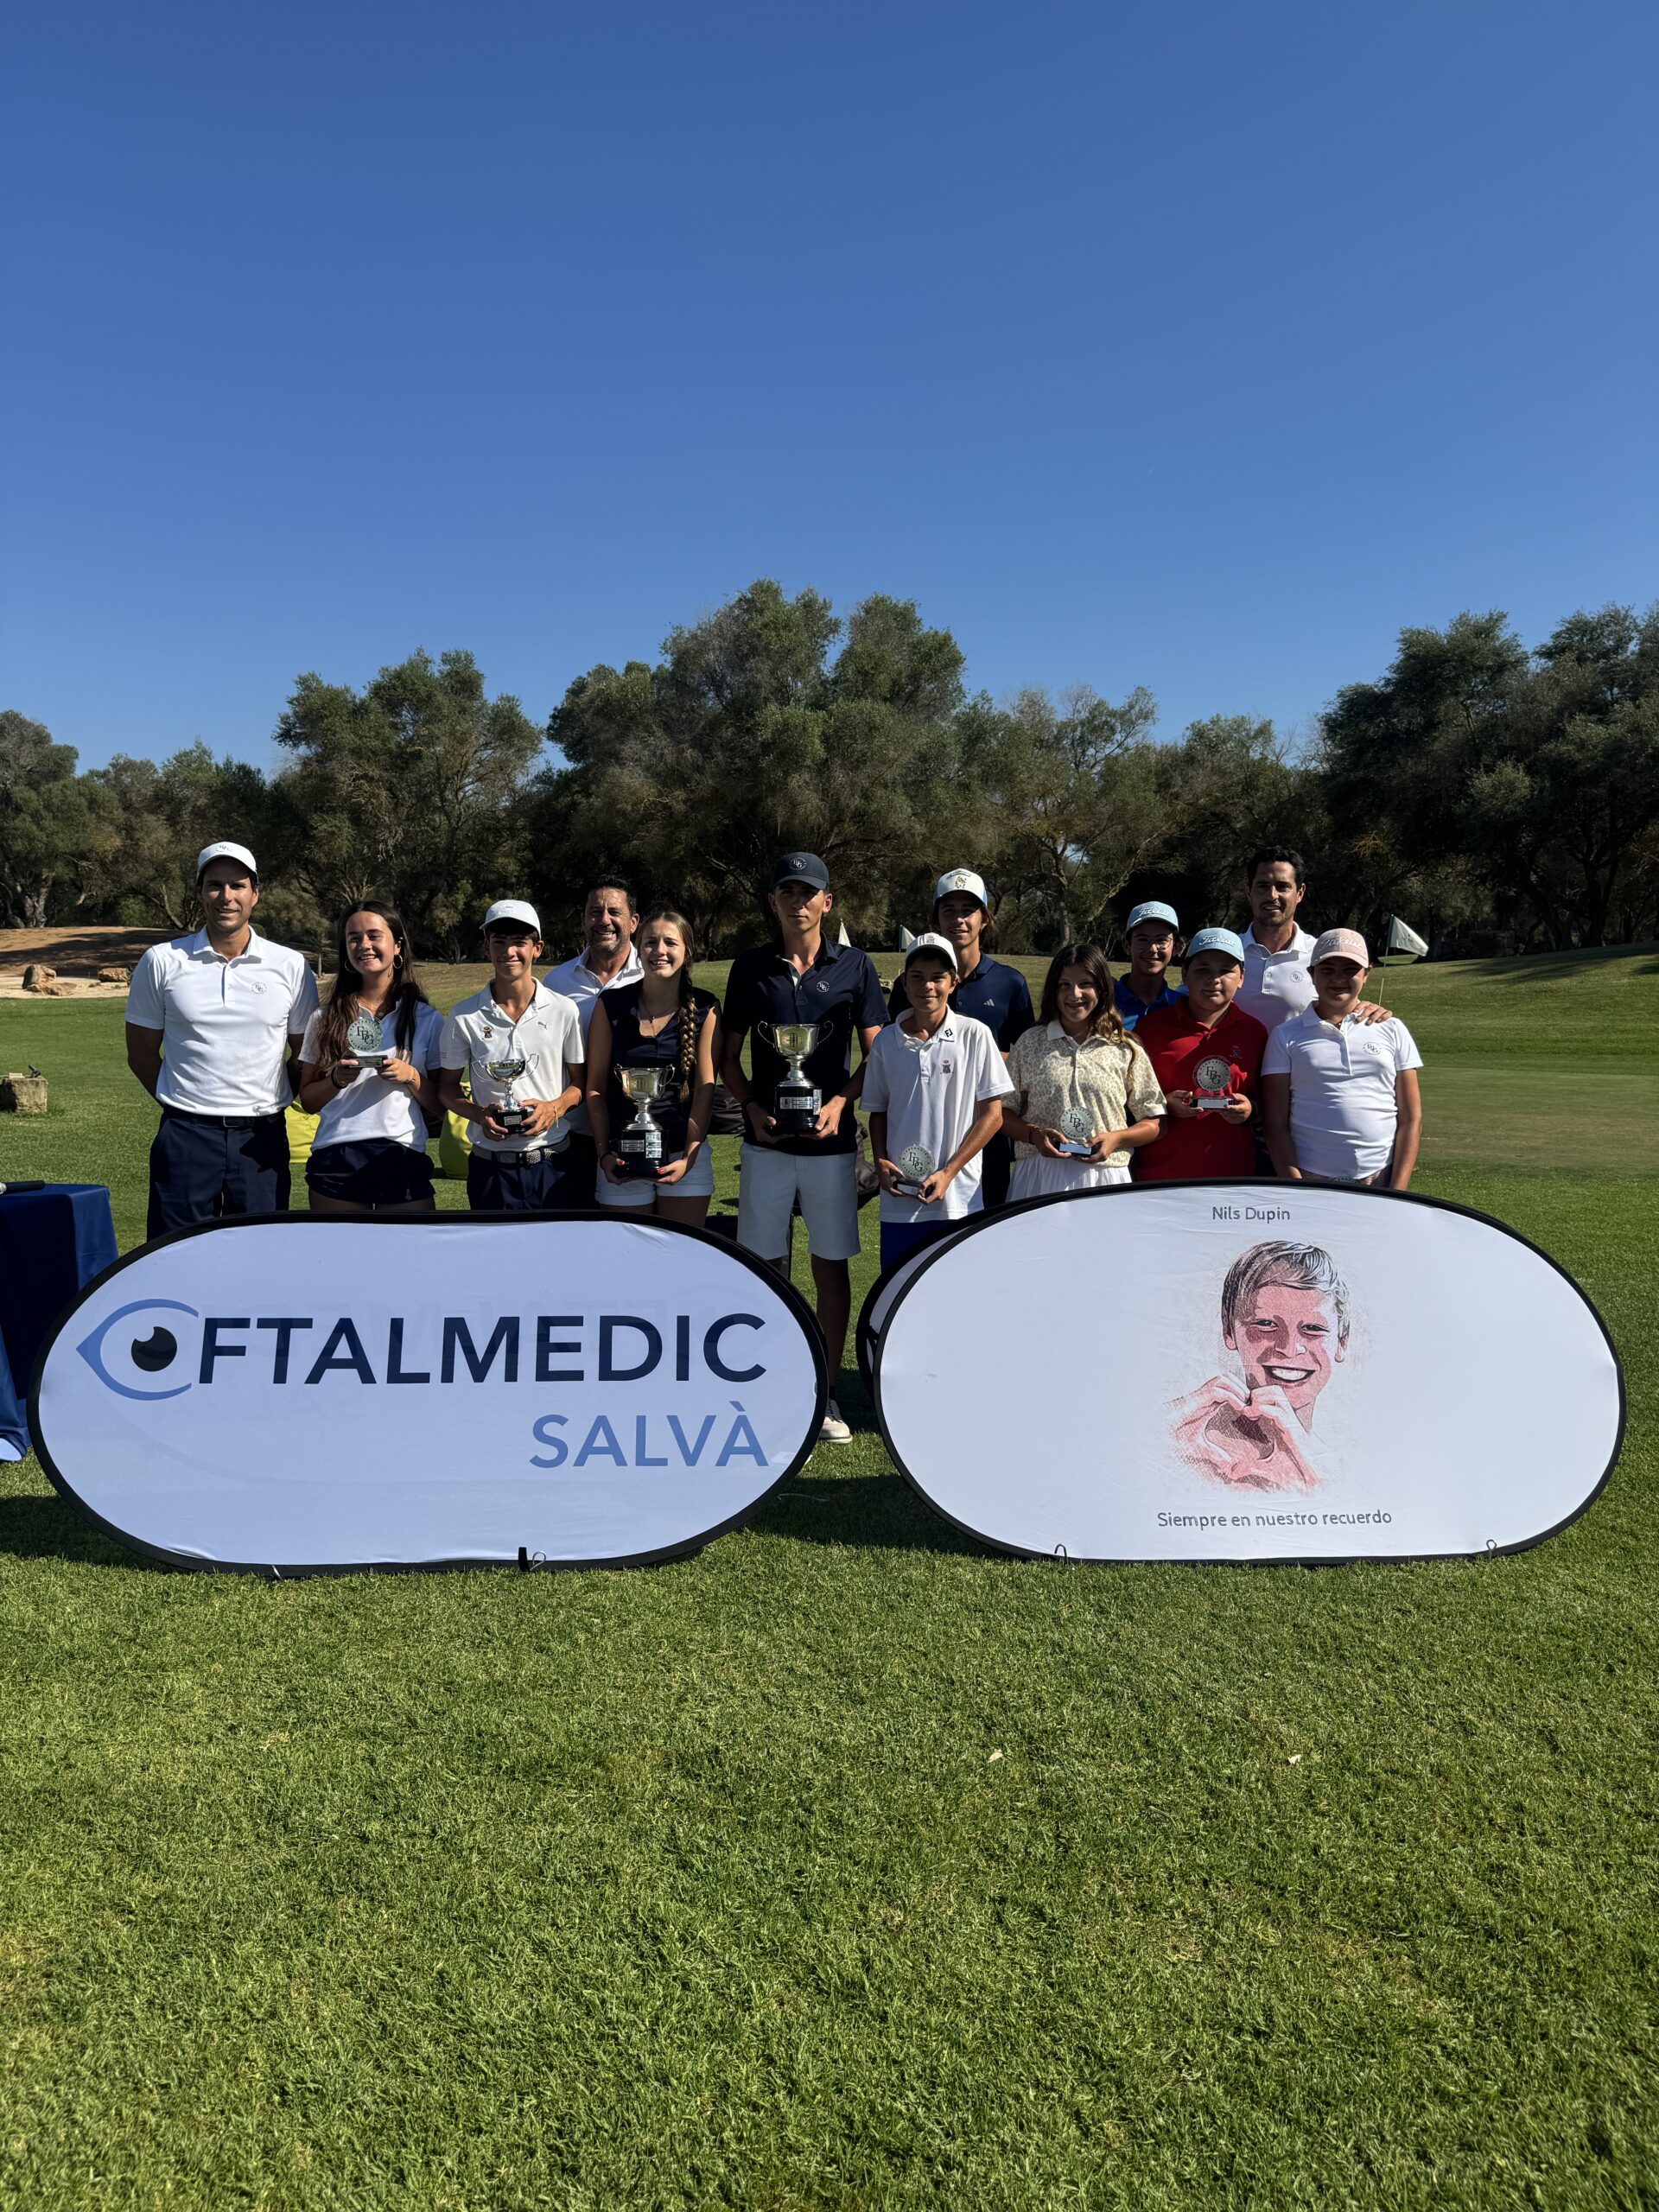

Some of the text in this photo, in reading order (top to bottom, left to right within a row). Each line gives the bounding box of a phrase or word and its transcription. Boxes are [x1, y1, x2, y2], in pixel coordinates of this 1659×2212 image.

[1212, 1205, 1291, 1224] Nils Dupin
[529, 1401, 769, 1469] SALVÀ
[1157, 1510, 1393, 1530] Siempre en nuestro recuerdo
